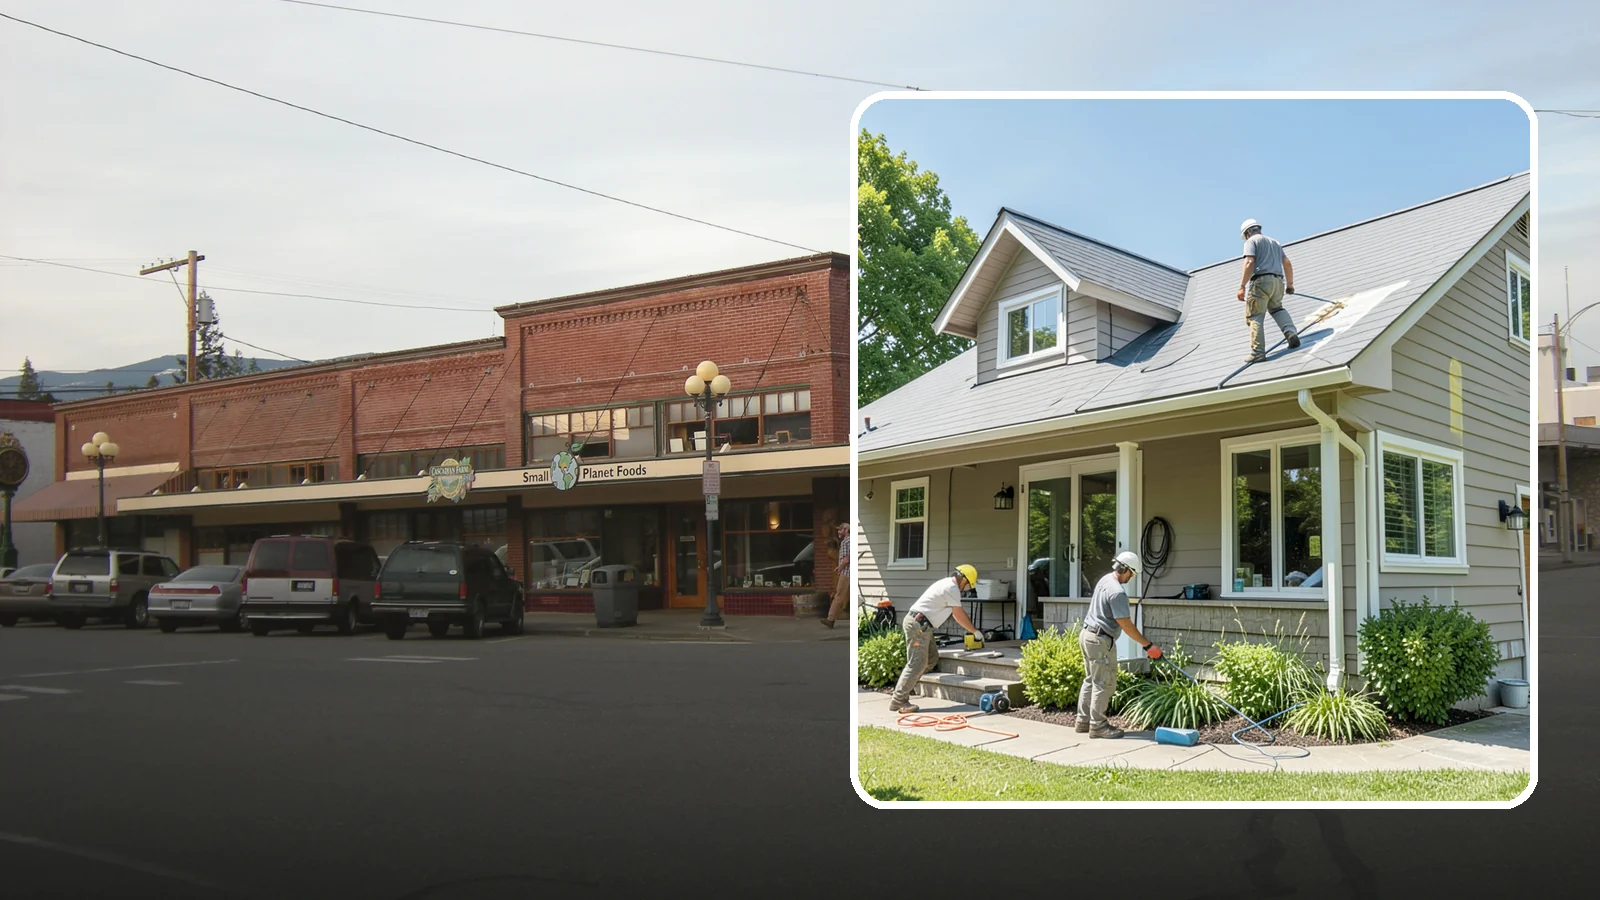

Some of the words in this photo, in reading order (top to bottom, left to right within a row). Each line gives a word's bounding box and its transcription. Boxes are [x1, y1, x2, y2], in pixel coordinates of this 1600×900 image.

[431, 467, 455, 476] CASCADIAN
[456, 466, 469, 474] FARM
[523, 471, 549, 482] Small
[583, 467, 613, 479] Planet
[617, 465, 647, 477] Foods
